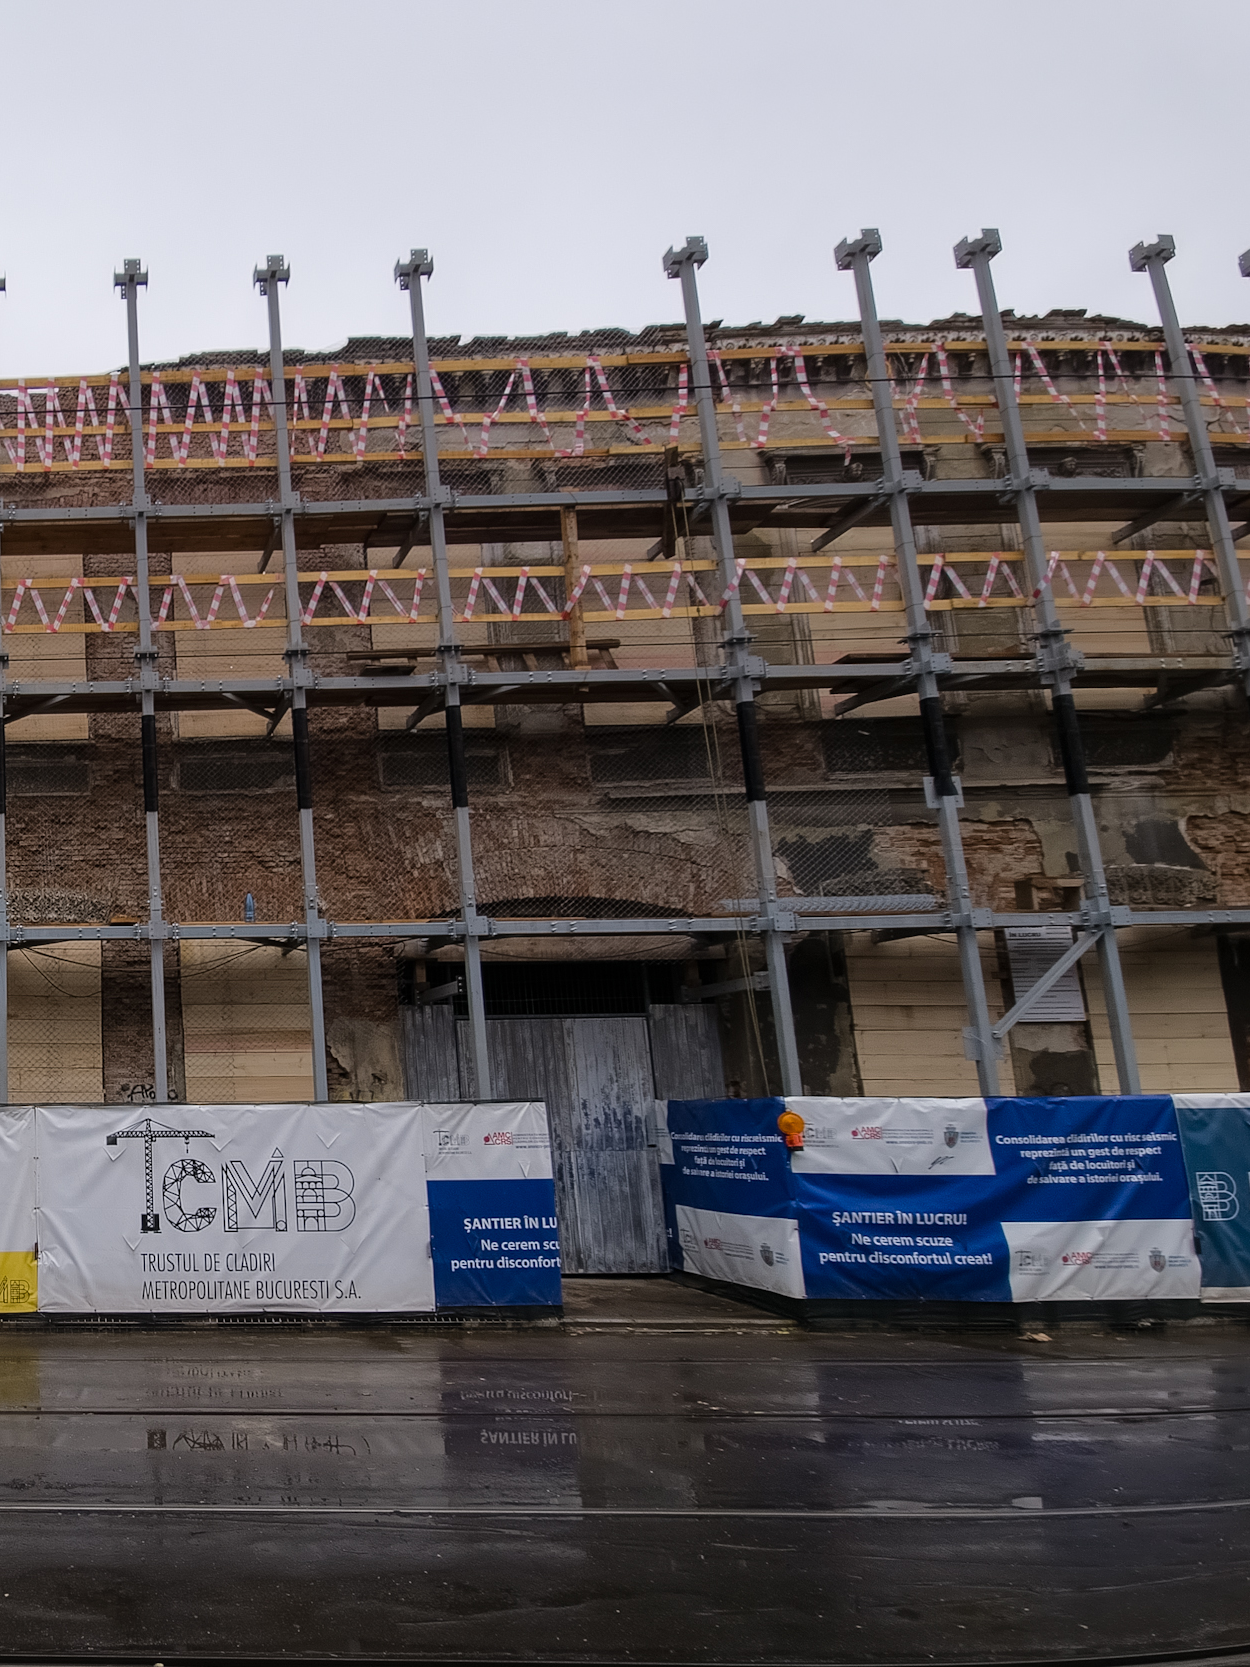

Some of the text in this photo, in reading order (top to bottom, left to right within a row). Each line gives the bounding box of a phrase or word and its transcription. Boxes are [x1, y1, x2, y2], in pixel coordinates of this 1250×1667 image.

[751, 1134, 783, 1143] seismic
[995, 1135, 1066, 1145] Consolidarea
[1124, 1132, 1141, 1142] risc
[1141, 1132, 1177, 1142] seismic
[716, 1146, 729, 1155] gest
[729, 1146, 738, 1154] de
[1070, 1149, 1086, 1157] un
[1088, 1147, 1110, 1158] gest
[1111, 1146, 1124, 1156] de
[1125, 1146, 1162, 1159] respect
[682, 1166, 690, 1175] de
[1069, 1160, 1085, 1170] de
[1086, 1160, 1126, 1170] locuitori
[106, 1118, 356, 1233] TCMB
[1027, 1175, 1038, 1184] de
[1039, 1174, 1077, 1184] salvare
[1086, 1173, 1118, 1183] istoriei
[463, 1218, 522, 1233] ȘANTIER
[523, 1215, 539, 1229] ÎN
[832, 1210, 967, 1226] ȘANTIER ÎN LUCRU!
[481, 1239, 499, 1251] Ne
[501, 1240, 540, 1251] cerem
[851, 1233, 953, 1246] Ne cerem scuze
[140, 1253, 276, 1273] TRUSTUL DE CLADIRI
[451, 1256, 561, 1272] pentru disconfort
[819, 1251, 993, 1265] pentru disconfortul creat!
[141, 1280, 362, 1300] METROPOLITANE BUCURESTI S.A.
